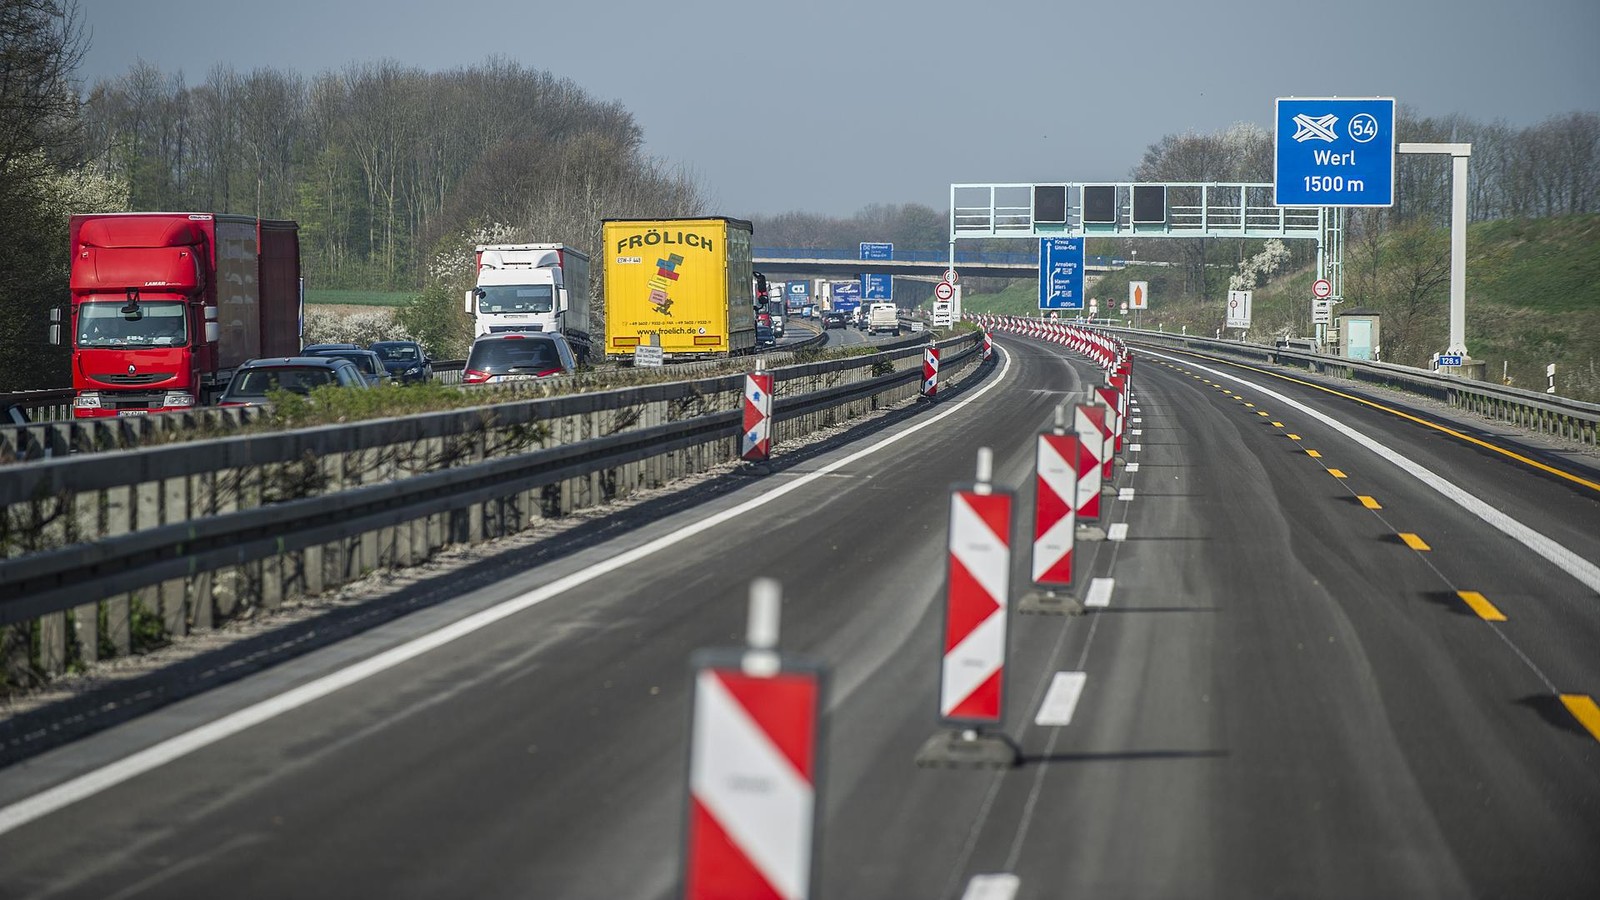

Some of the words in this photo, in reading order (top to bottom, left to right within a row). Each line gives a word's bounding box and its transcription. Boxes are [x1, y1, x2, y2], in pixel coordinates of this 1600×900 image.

[1353, 120, 1374, 136] 54
[1313, 149, 1356, 166] Werl
[1303, 175, 1343, 192] 1500
[1347, 179, 1364, 192] m
[617, 229, 713, 254] FRÖLICH
